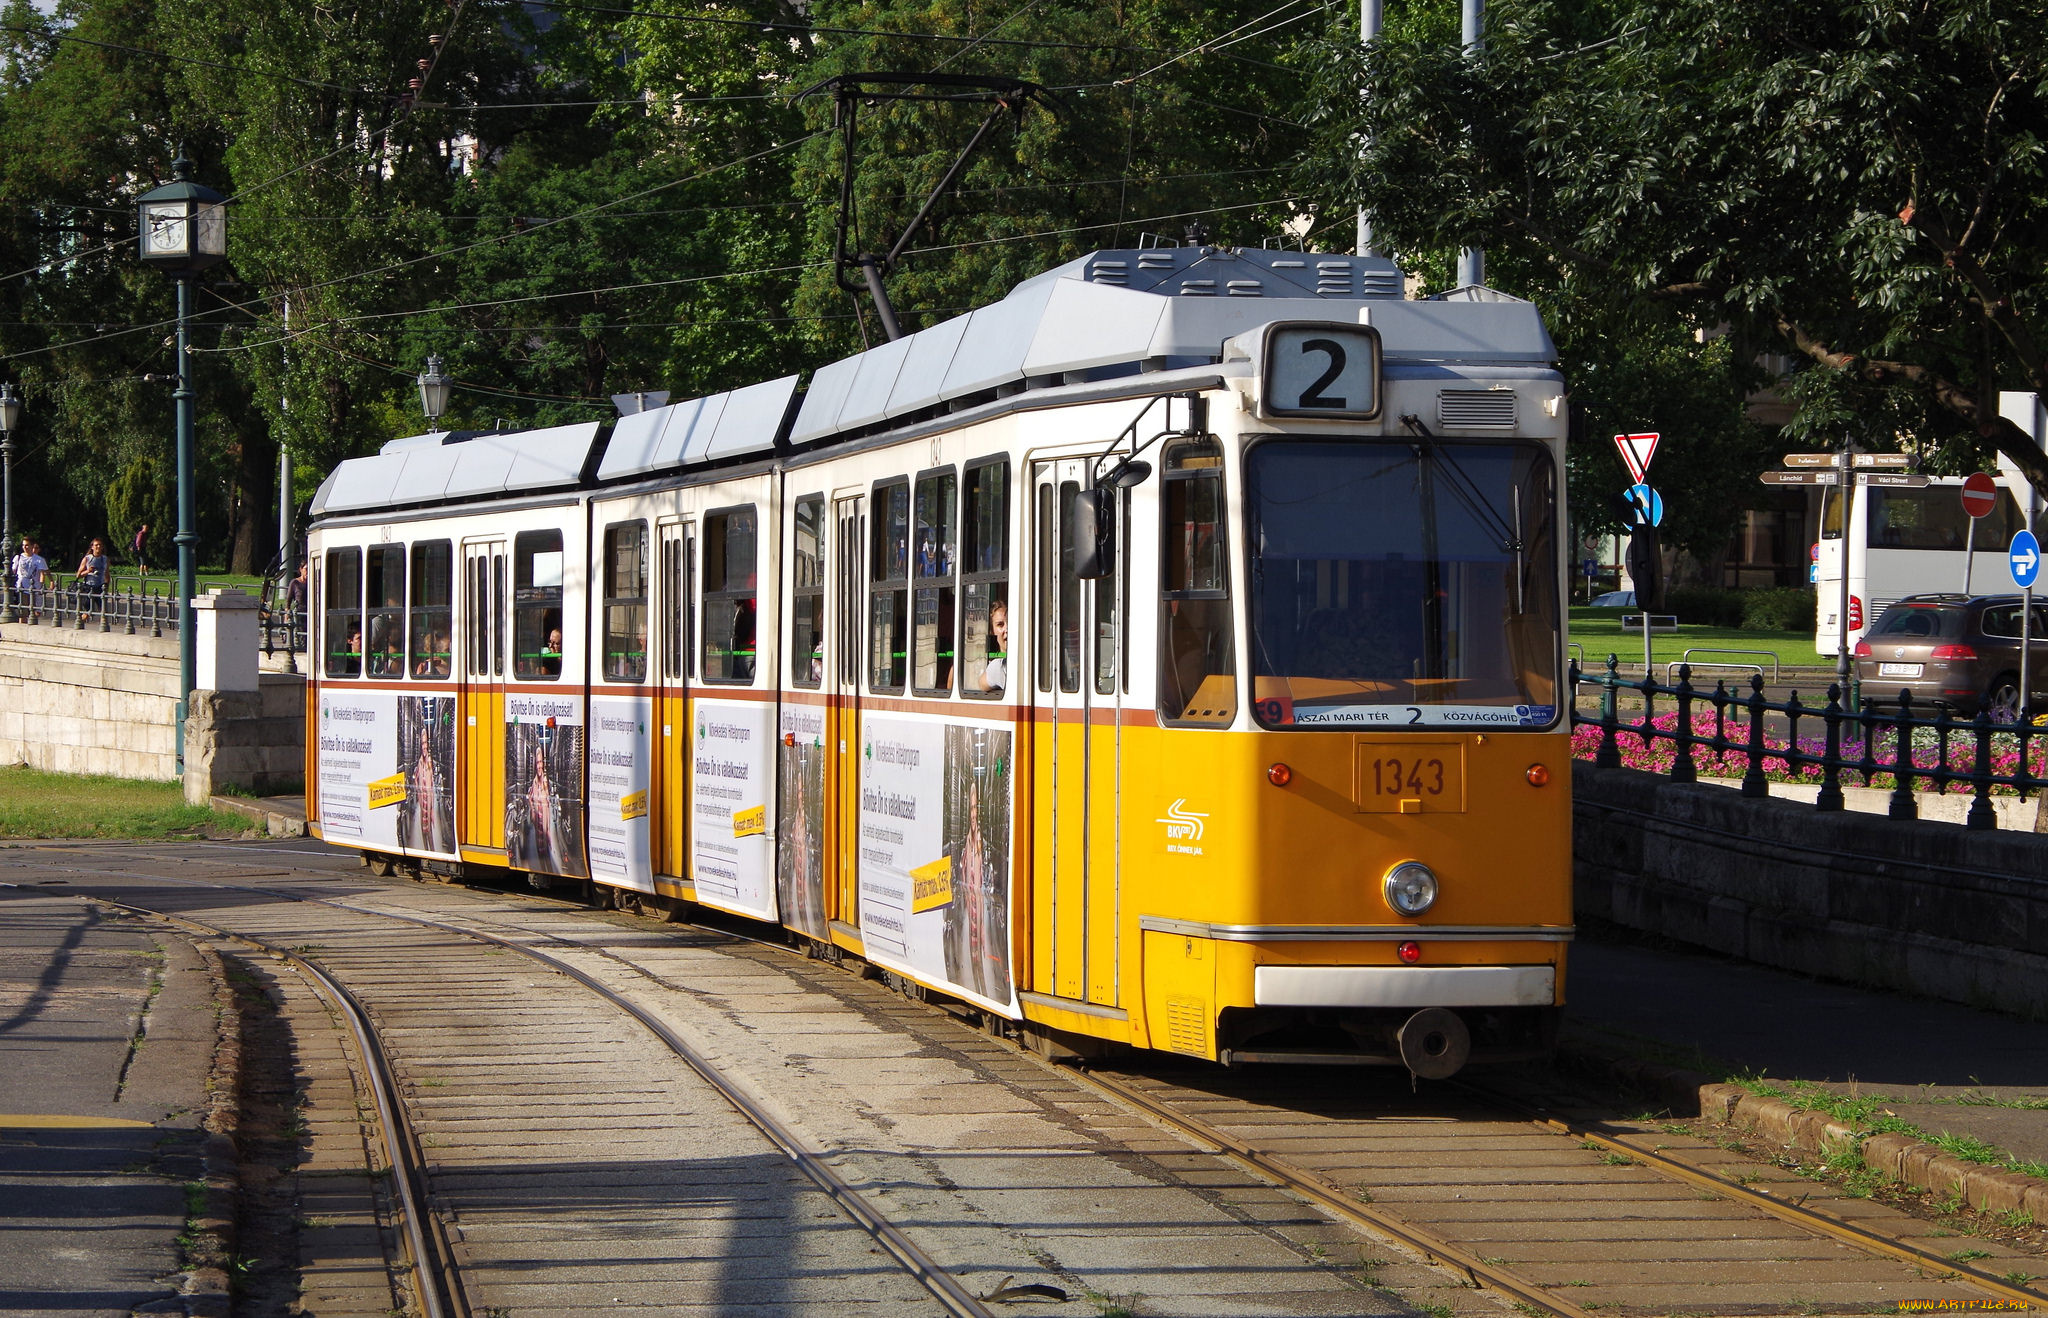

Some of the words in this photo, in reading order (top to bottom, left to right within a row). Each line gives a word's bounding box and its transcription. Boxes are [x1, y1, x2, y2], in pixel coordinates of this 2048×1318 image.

[1299, 339, 1346, 408] 2
[536, 700, 540, 716] is
[1406, 707, 1424, 724] 2
[1334, 713, 1364, 722] MARI
[1367, 712, 1390, 720] TÉR
[717, 760, 720, 776] is
[1373, 758, 1444, 795] 1343
[1168, 825, 1183, 839] BKV
